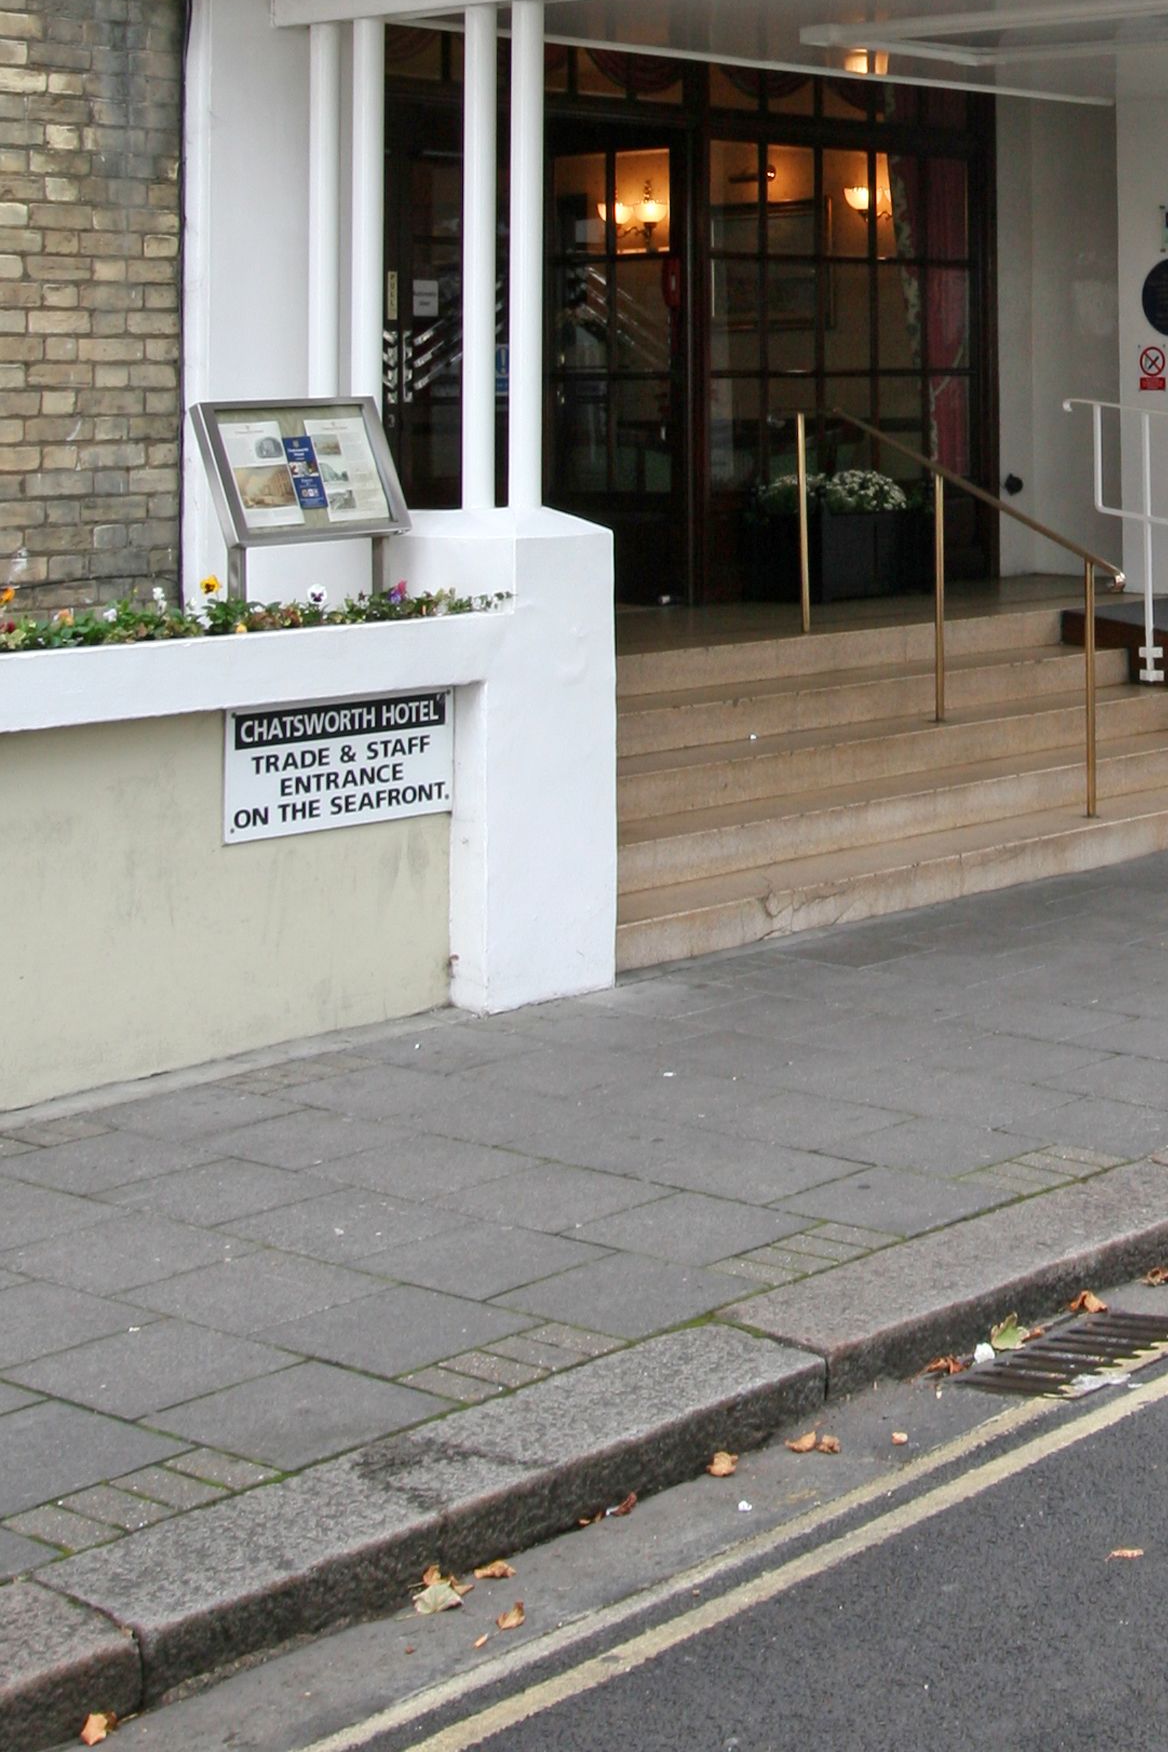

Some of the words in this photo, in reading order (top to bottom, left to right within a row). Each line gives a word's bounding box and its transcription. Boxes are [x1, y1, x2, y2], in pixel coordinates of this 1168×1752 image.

[240, 706, 376, 744] CHATSWORTH
[382, 699, 439, 726] HOTEL
[251, 747, 330, 774] TRADE
[339, 745, 357, 764] &
[366, 735, 431, 760] STAFF
[280, 763, 404, 797] ENTRANCE
[233, 806, 269, 829] ON
[278, 799, 321, 823] THE
